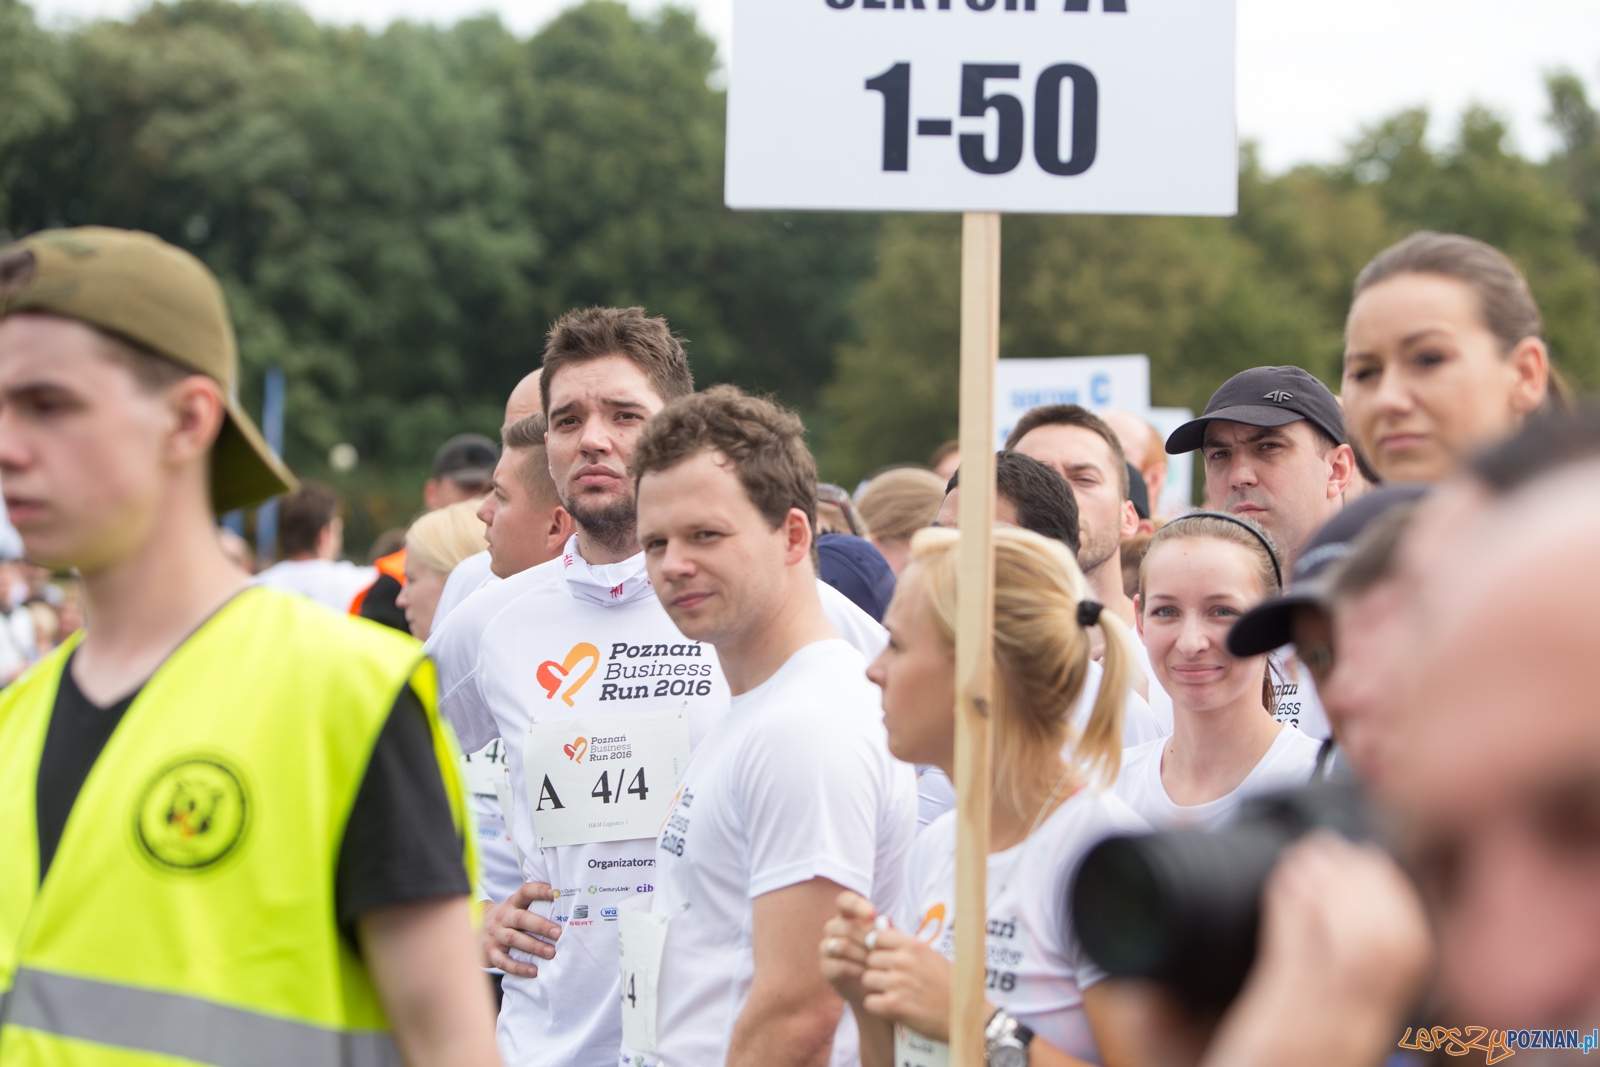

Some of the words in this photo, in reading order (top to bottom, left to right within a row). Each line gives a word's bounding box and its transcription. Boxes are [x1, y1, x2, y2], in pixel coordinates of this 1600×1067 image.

[864, 61, 1099, 176] 1-50
[1262, 390, 1294, 403] 4F
[609, 641, 702, 660] Poznań
[604, 660, 712, 680] Business
[599, 683, 649, 701] Run
[654, 680, 712, 697] 2016
[591, 734, 627, 745] Poznań
[589, 752, 609, 762] Run
[610, 750, 632, 761] 2016
[590, 743, 631, 754] Business
[535, 773, 566, 811] A
[591, 767, 649, 804] 4/4
[636, 884, 654, 893] cib
